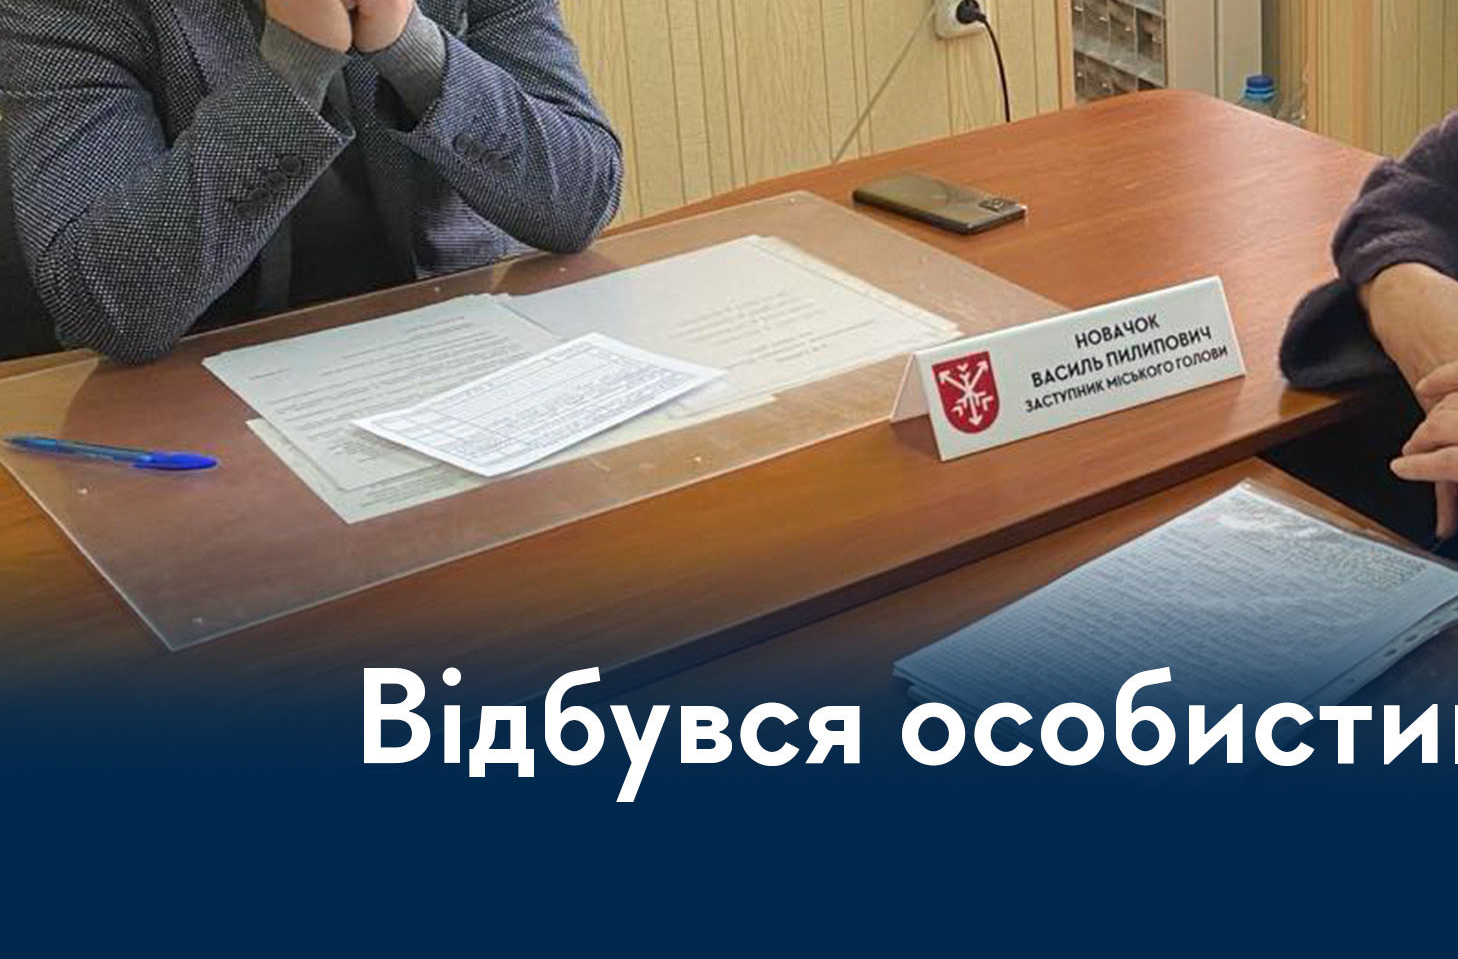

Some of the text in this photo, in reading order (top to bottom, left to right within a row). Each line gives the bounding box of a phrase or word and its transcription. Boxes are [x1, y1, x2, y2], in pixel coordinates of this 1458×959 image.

[1030, 325, 1213, 388] ВАСИЛЬ ПИЛИПОВИЧ
[1074, 313, 1160, 349] НОВАЧОК
[1025, 344, 1229, 413] ЗАСТУПНИК МІСЬКОГО ГОЛОВИ
